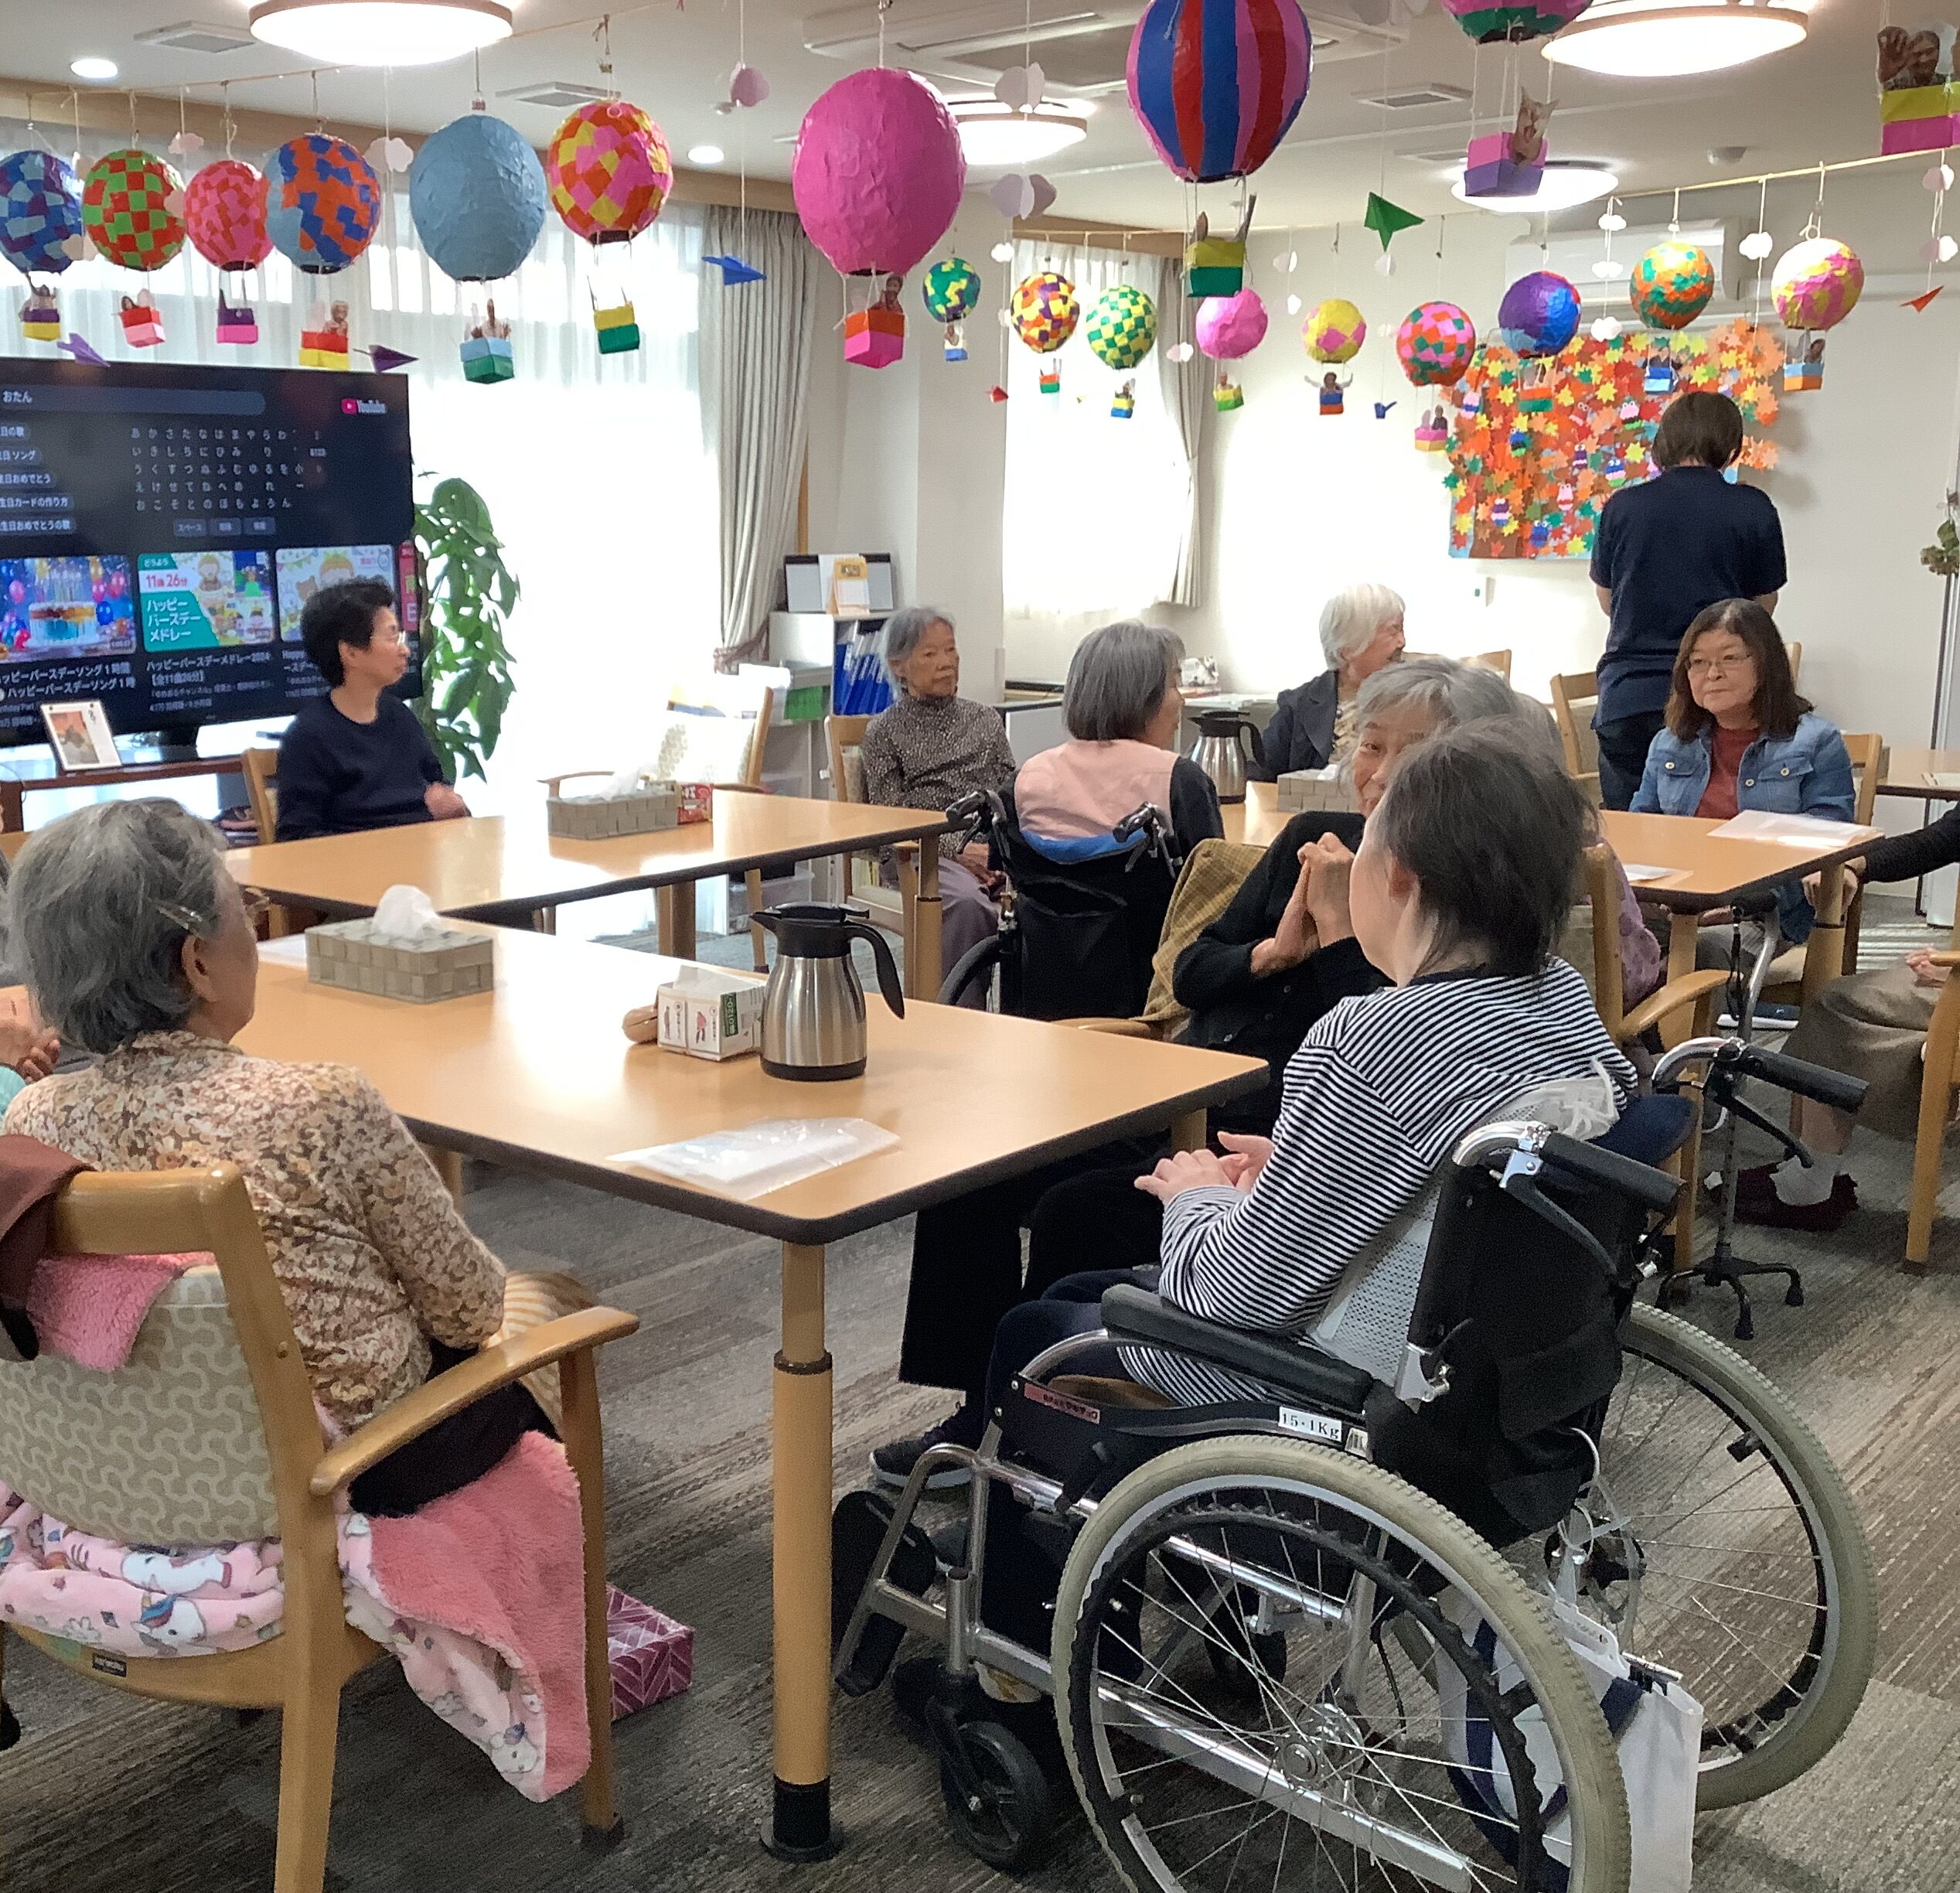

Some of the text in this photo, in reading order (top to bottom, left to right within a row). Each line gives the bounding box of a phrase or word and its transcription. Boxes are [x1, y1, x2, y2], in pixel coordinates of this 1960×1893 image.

[3, 391, 32, 403] おたん
[0, 450, 36, 460] 日 ソング
[0, 520, 70, 531] 生日おめでとうの歌
[147, 597, 188, 612] ハッピー
[148, 612, 201, 627] バースデー
[150, 628, 191, 642] メドレー
[0, 662, 131, 684] ッピーバースデーソング1時間
